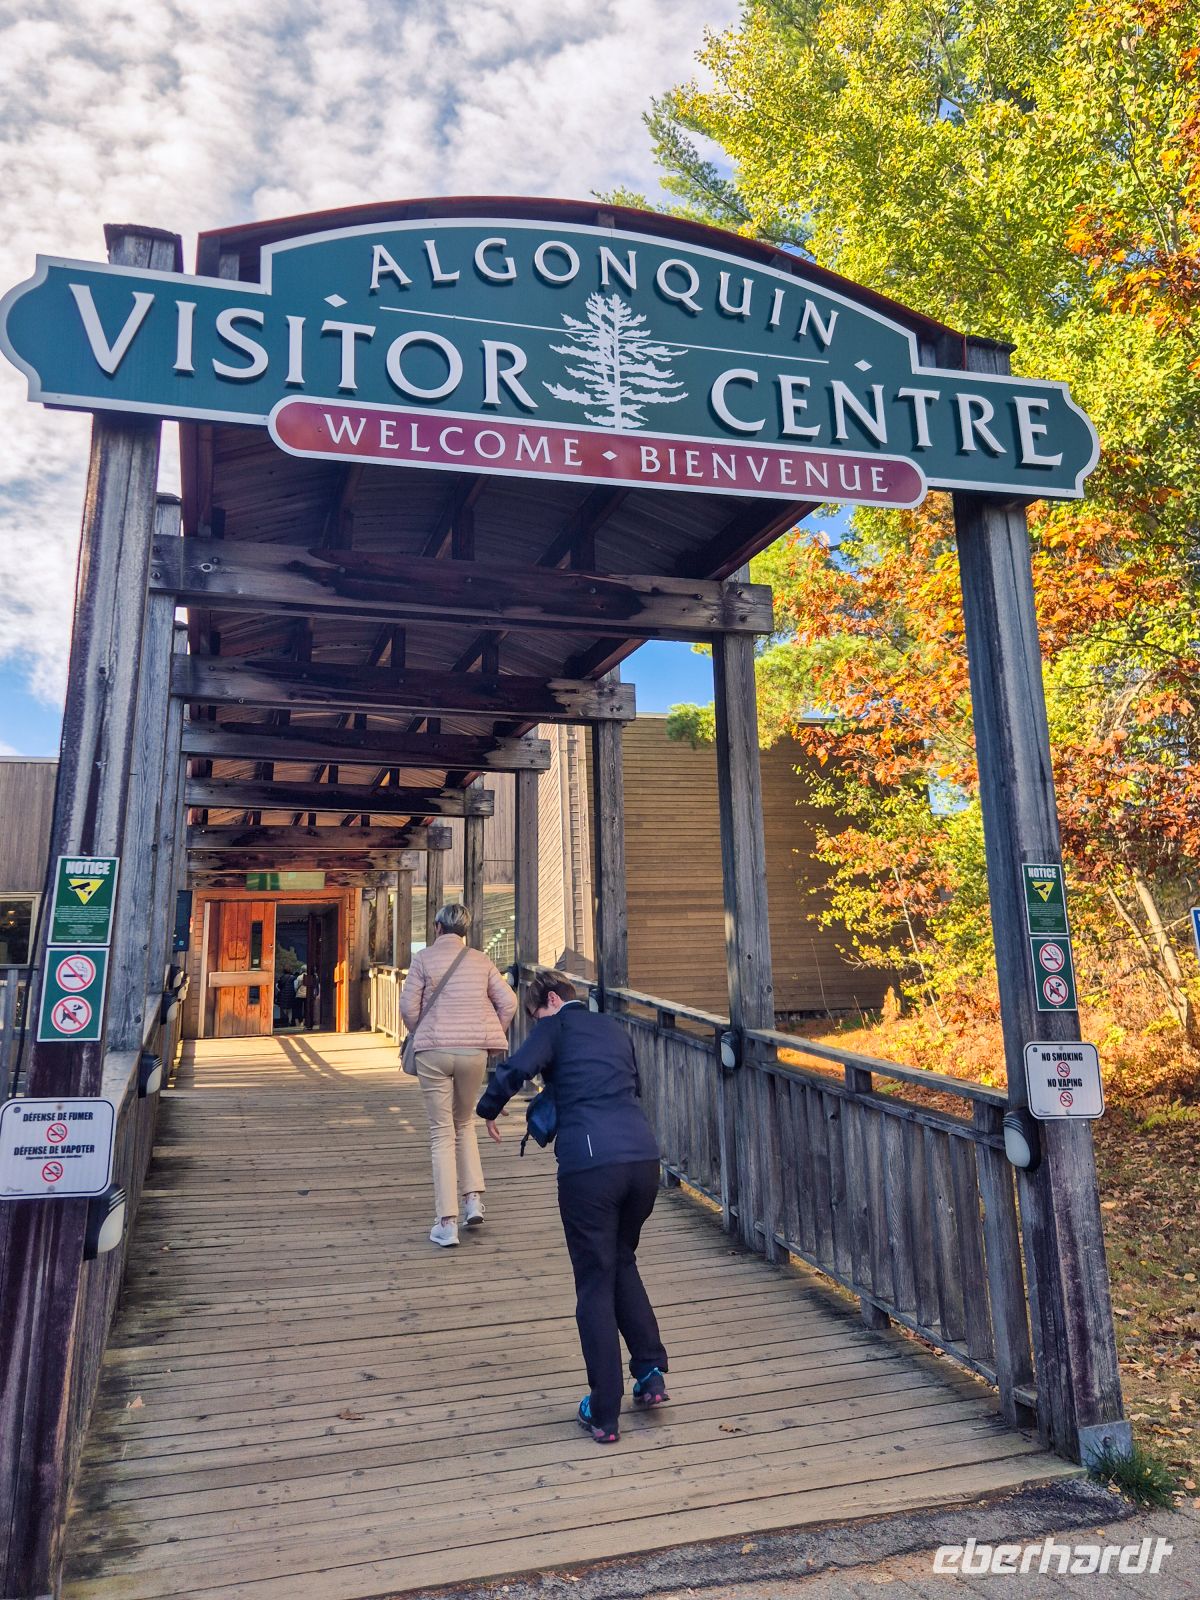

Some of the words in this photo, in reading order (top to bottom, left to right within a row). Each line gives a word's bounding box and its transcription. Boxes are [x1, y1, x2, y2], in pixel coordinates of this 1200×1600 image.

[369, 237, 839, 347] ALGONQUIN
[68, 283, 539, 409] VISITOR
[711, 368, 1064, 467] CENTRE
[323, 413, 584, 467] WELCOME
[639, 445, 889, 494] BIENVENUE
[65, 861, 111, 875] NOTICE
[1028, 867, 1057, 879] NOTICE
[1041, 1052, 1051, 1062] NO
[1052, 1052, 1084, 1062] SMOKING
[1047, 1078, 1057, 1088] NO
[1058, 1078, 1083, 1088] VAPING
[22, 1111, 56, 1122] DÉFENSE
[57, 1112, 67, 1121] DE
[68, 1111, 94, 1121] FUMER
[13, 1144, 47, 1156] DÉFENSE
[48, 1145, 59, 1155] DE
[60, 1144, 95, 1154] VAPOTER
